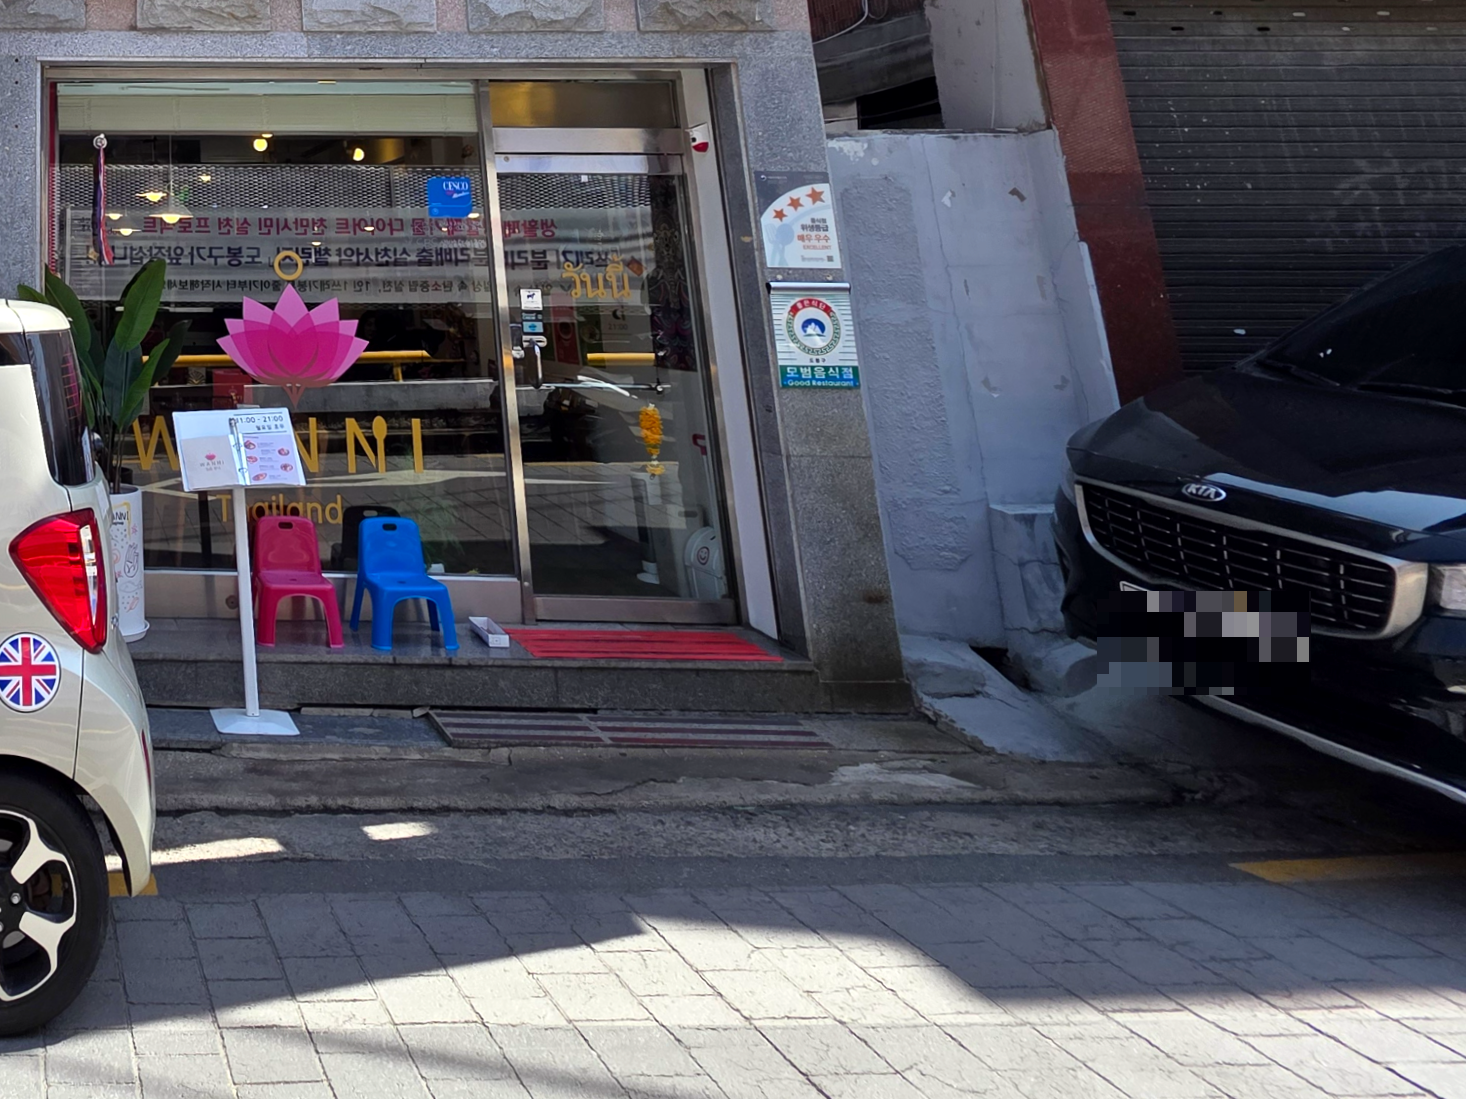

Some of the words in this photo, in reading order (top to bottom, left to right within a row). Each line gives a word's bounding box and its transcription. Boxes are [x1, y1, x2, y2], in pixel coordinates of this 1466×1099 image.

[797, 233, 813, 243] 매우
[814, 233, 831, 243] 우수
[562, 254, 632, 299] วันนี้
[786, 366, 854, 379] 모범음식점
[812, 379, 854, 387] Restaurant
[263, 415, 283, 423] 21:00
[132, 414, 424, 474] WNNI
[1187, 483, 1216, 499] KIA
[216, 493, 343, 525] Tailand
